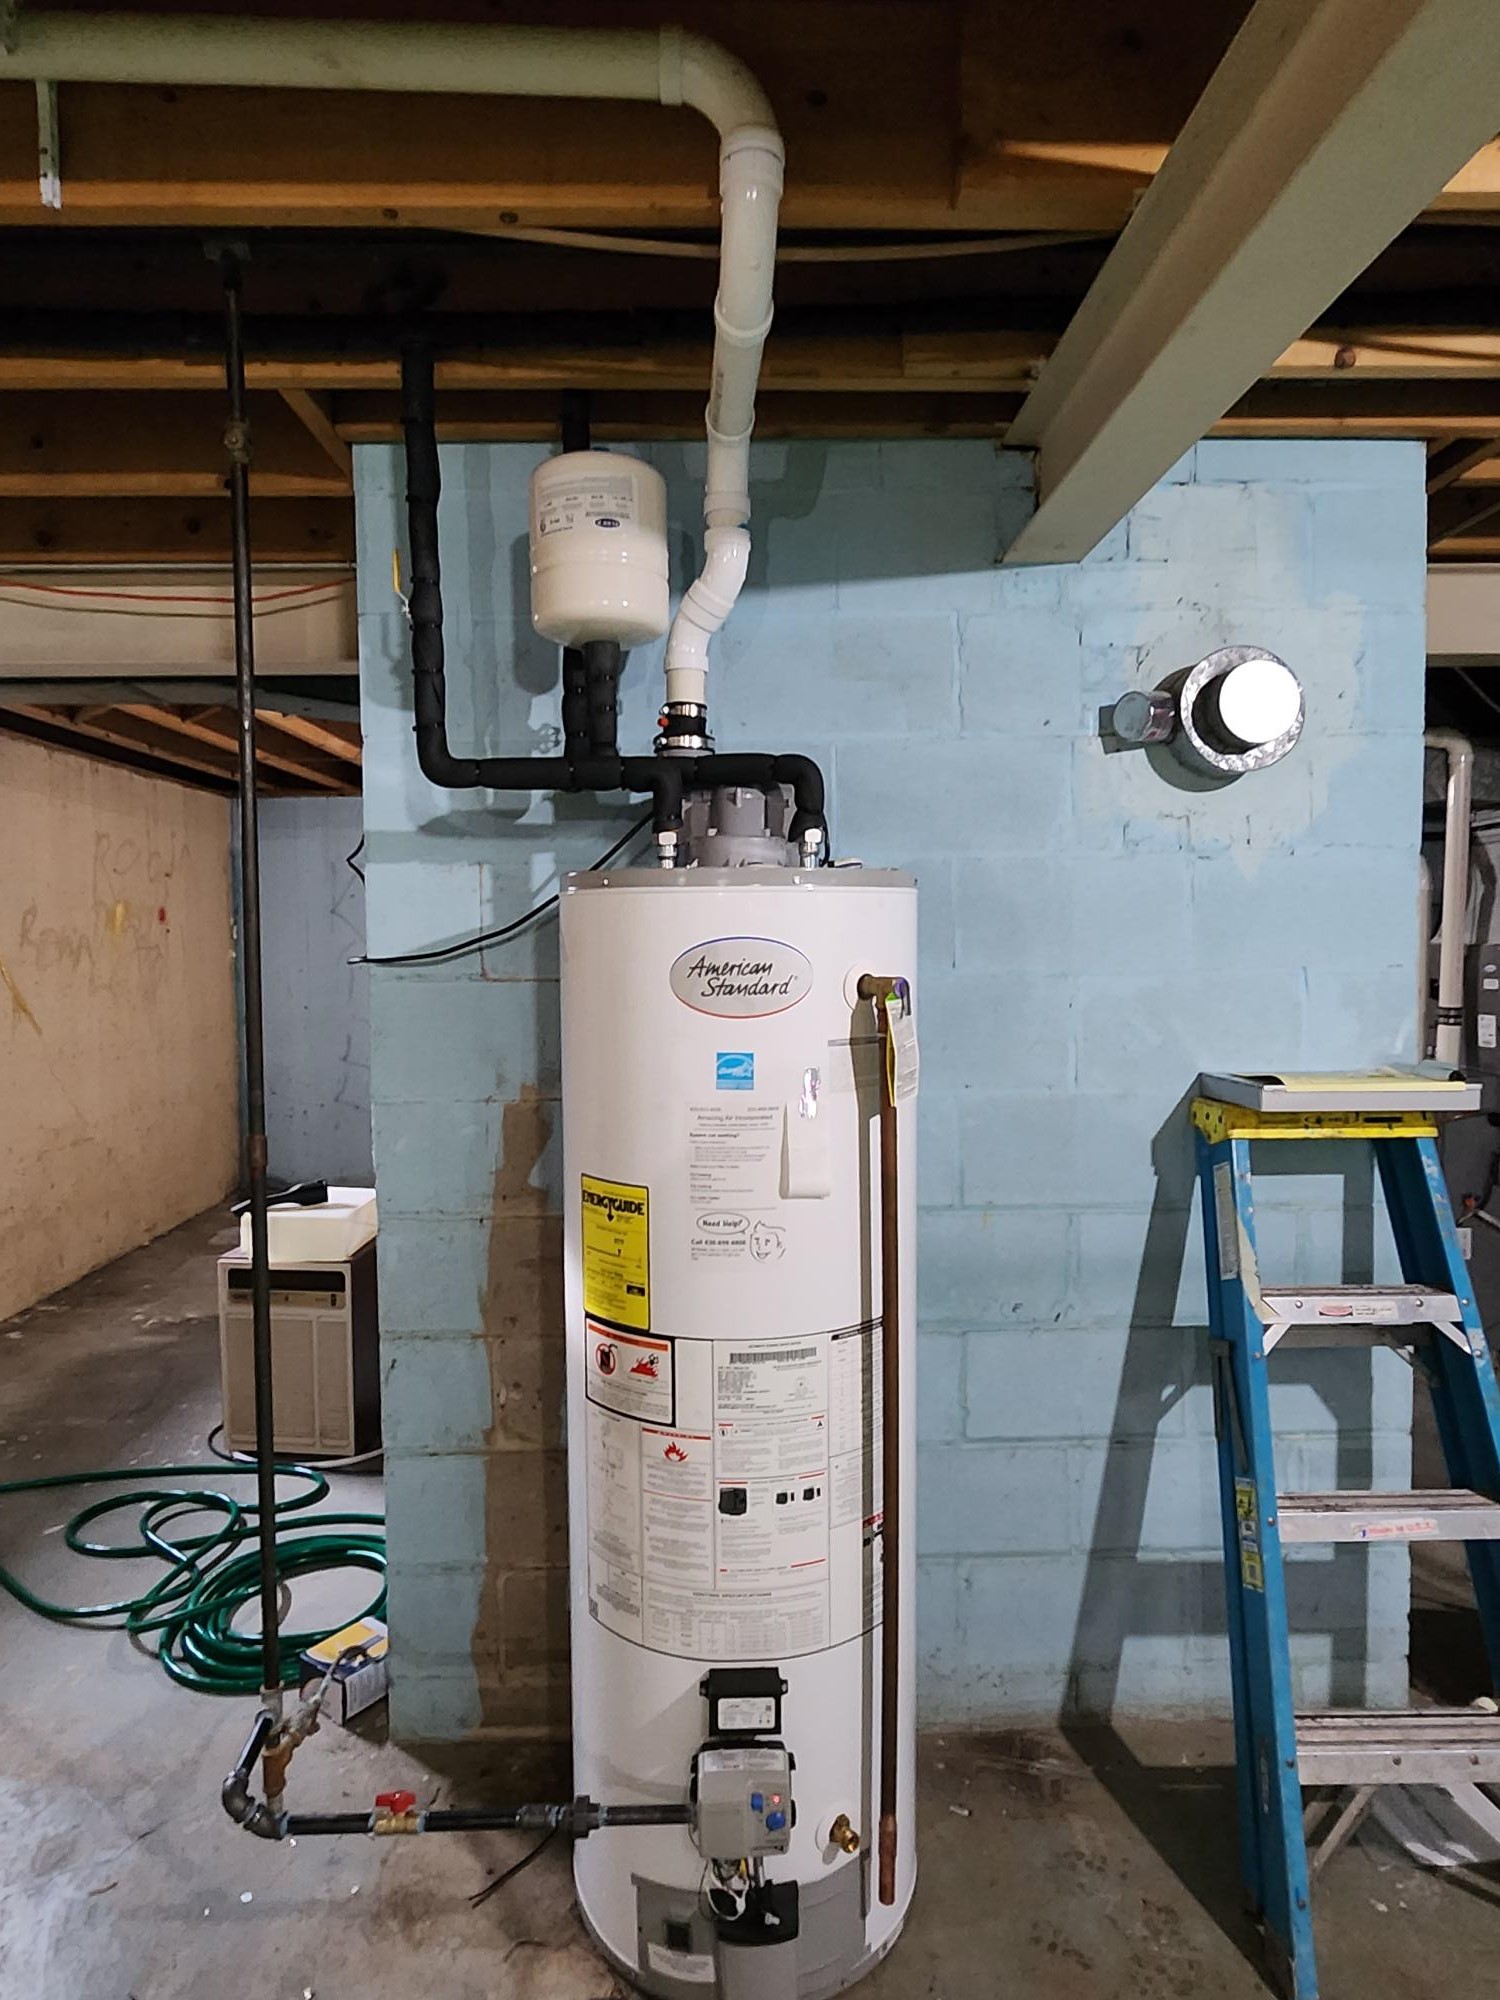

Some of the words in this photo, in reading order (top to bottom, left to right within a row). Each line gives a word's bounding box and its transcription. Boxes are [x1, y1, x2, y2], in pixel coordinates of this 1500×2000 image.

[687, 955, 773, 978] American
[701, 974, 794, 997] Standard
[702, 1219, 720, 1228] Need
